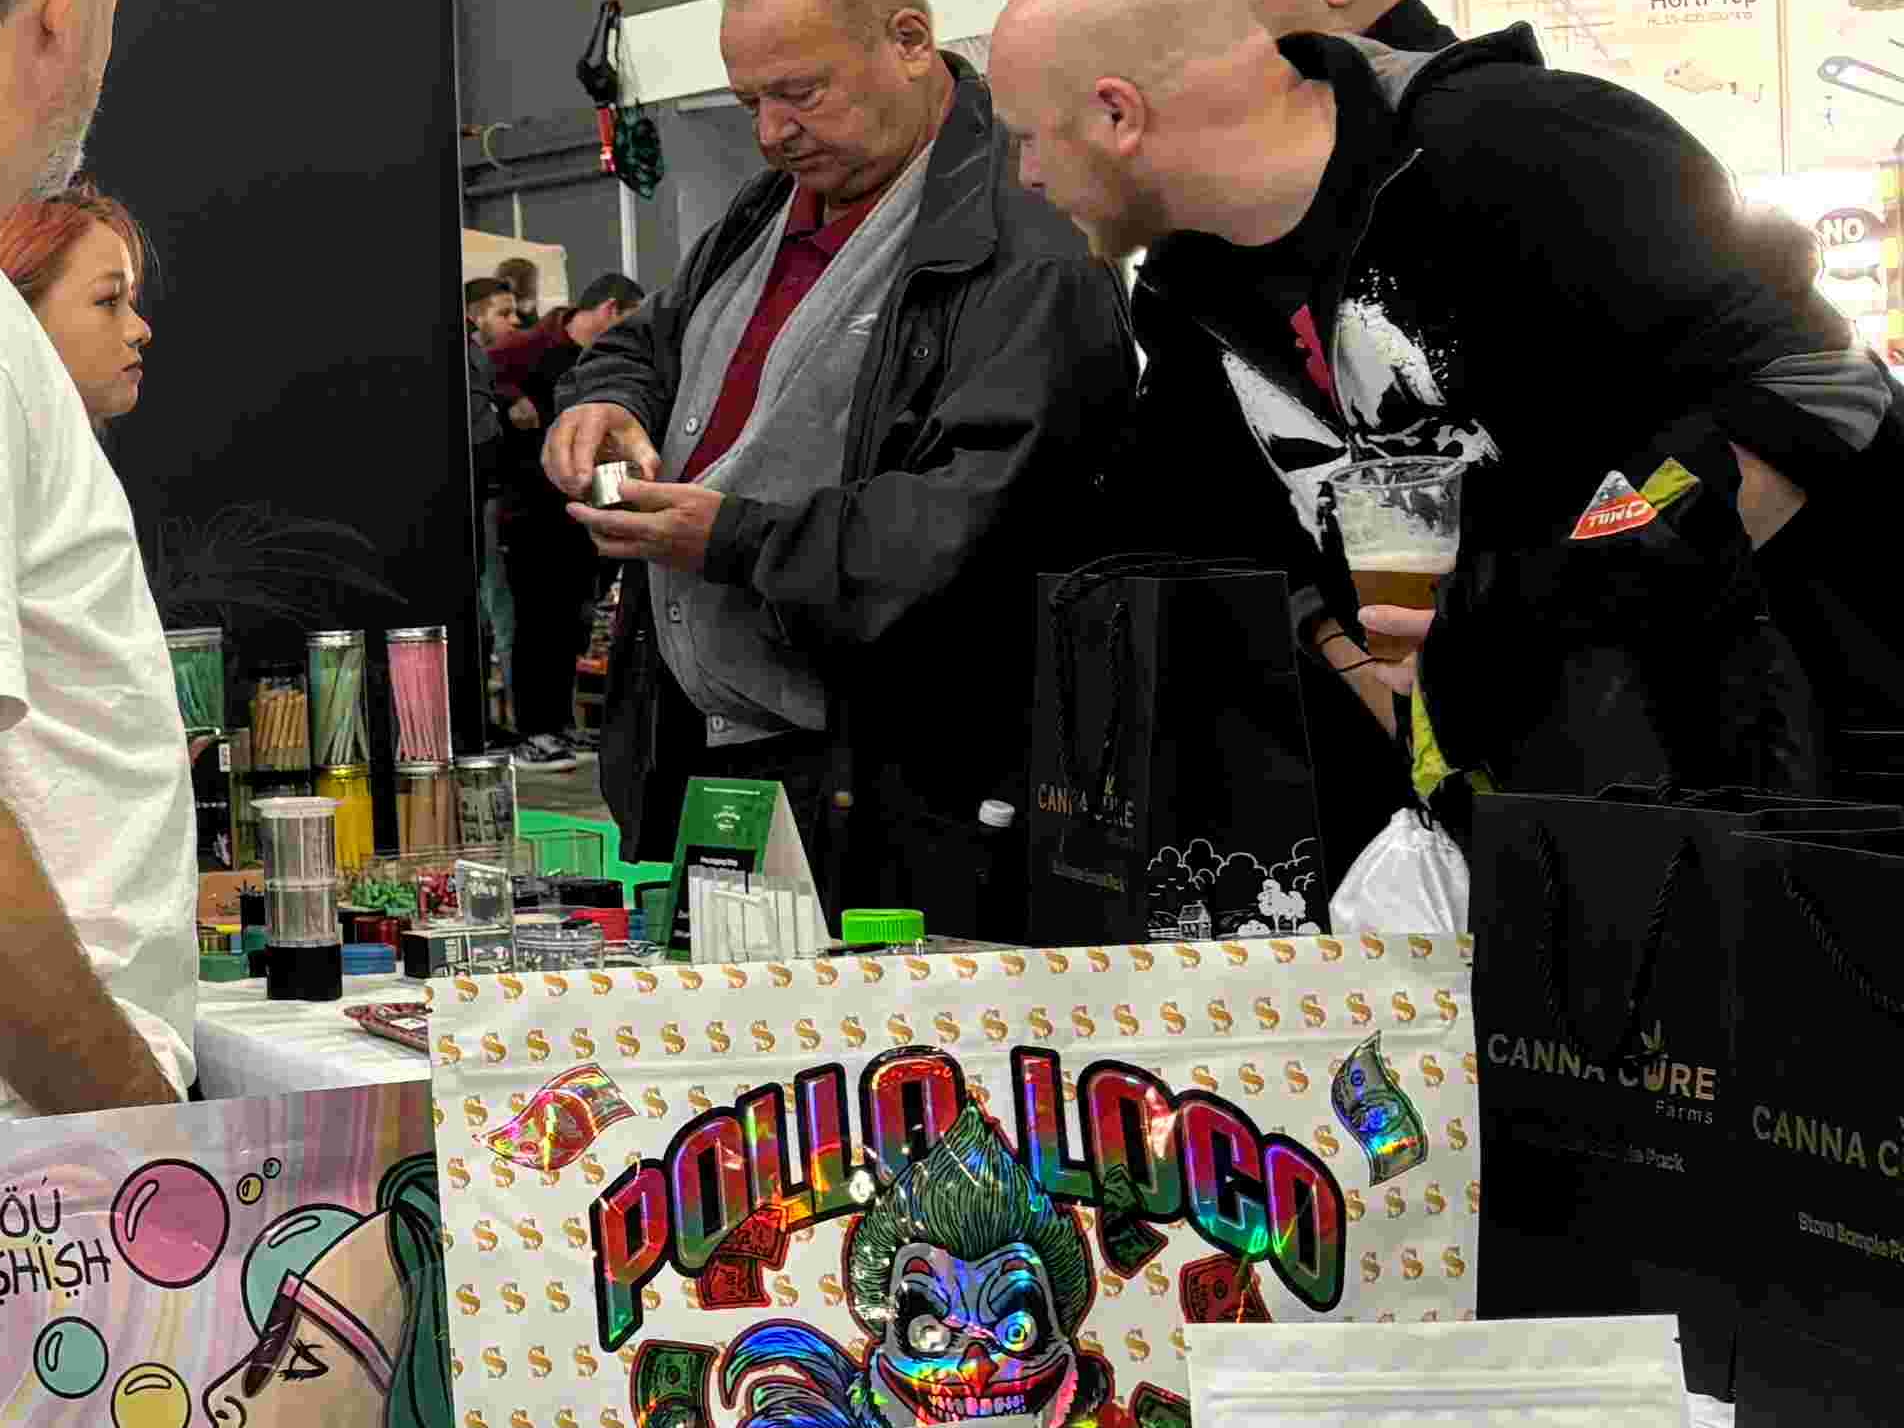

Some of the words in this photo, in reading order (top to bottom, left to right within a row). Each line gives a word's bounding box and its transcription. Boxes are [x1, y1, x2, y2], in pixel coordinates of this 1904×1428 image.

[590, 1047, 967, 1352] POLLO
[1011, 1045, 1347, 1313] LOCO
[1752, 1106, 1868, 1170] CANNA
